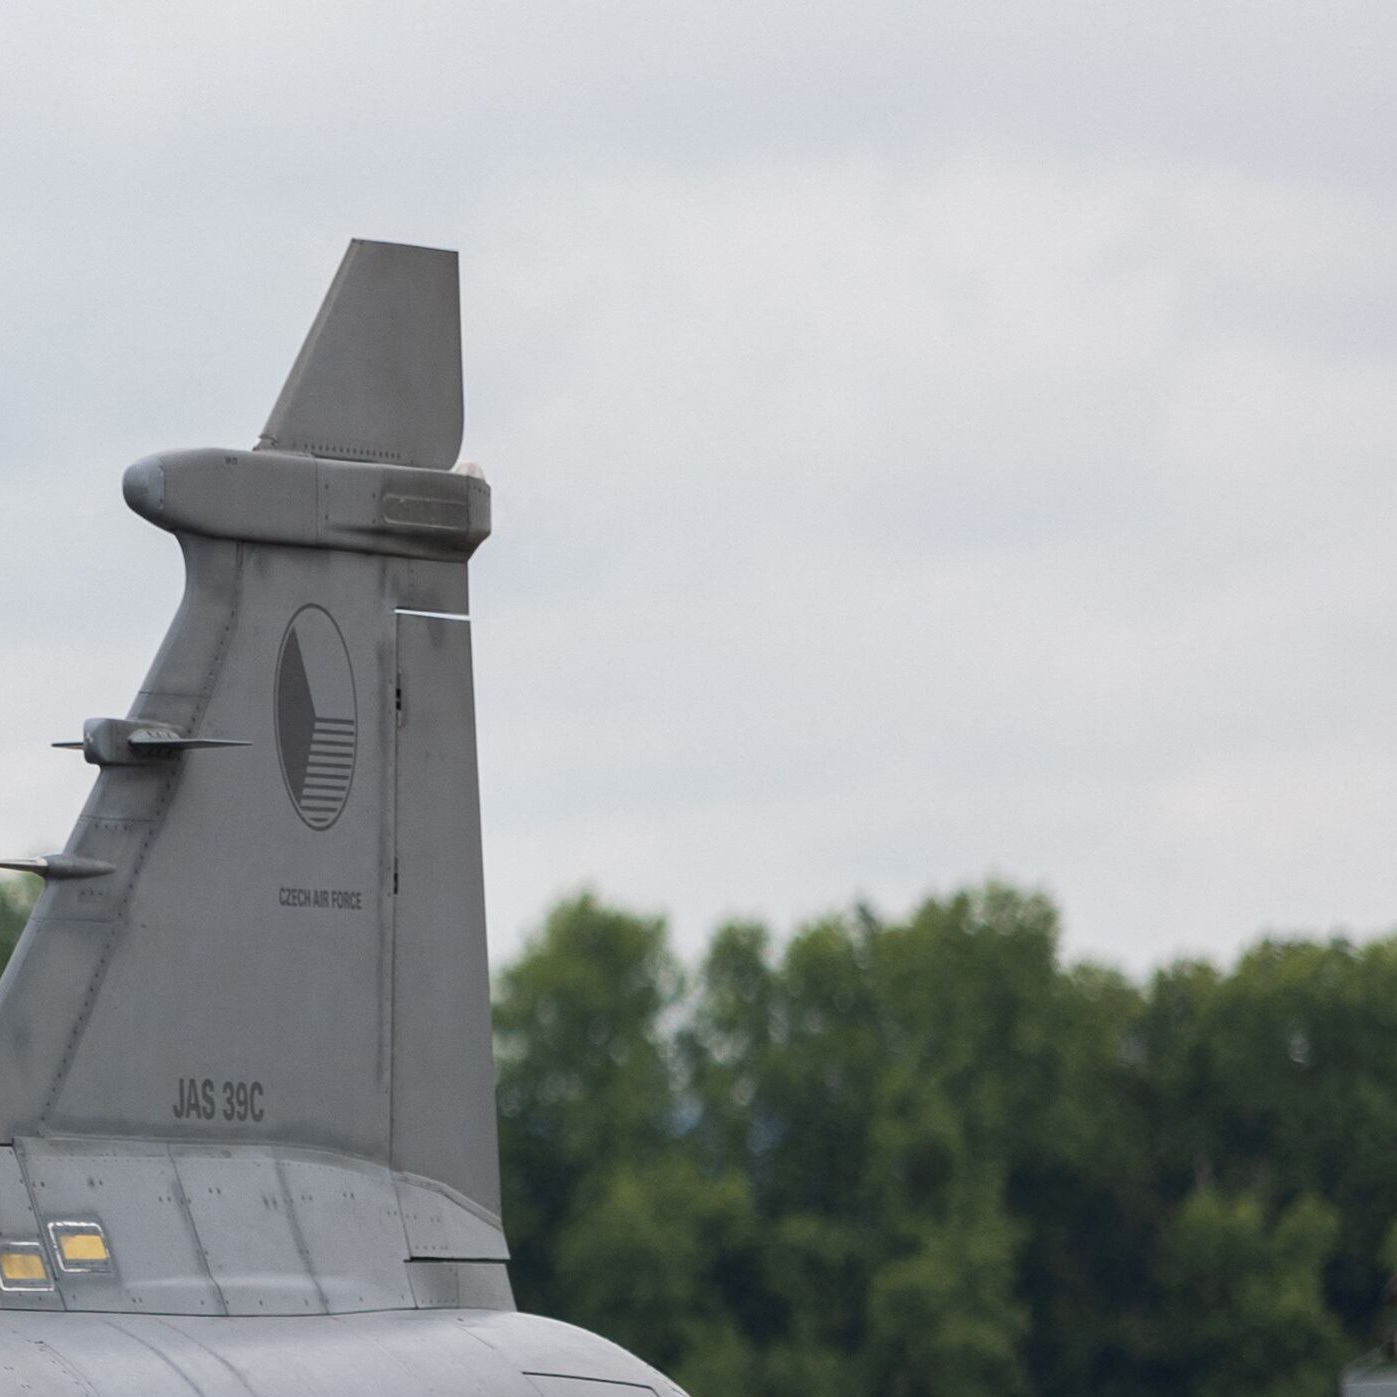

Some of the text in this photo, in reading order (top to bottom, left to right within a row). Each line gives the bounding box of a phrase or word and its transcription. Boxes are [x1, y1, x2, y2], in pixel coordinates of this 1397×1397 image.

[279, 887, 362, 910] CZECH AIR FORCE
[172, 1078, 264, 1122] JAS 39C
